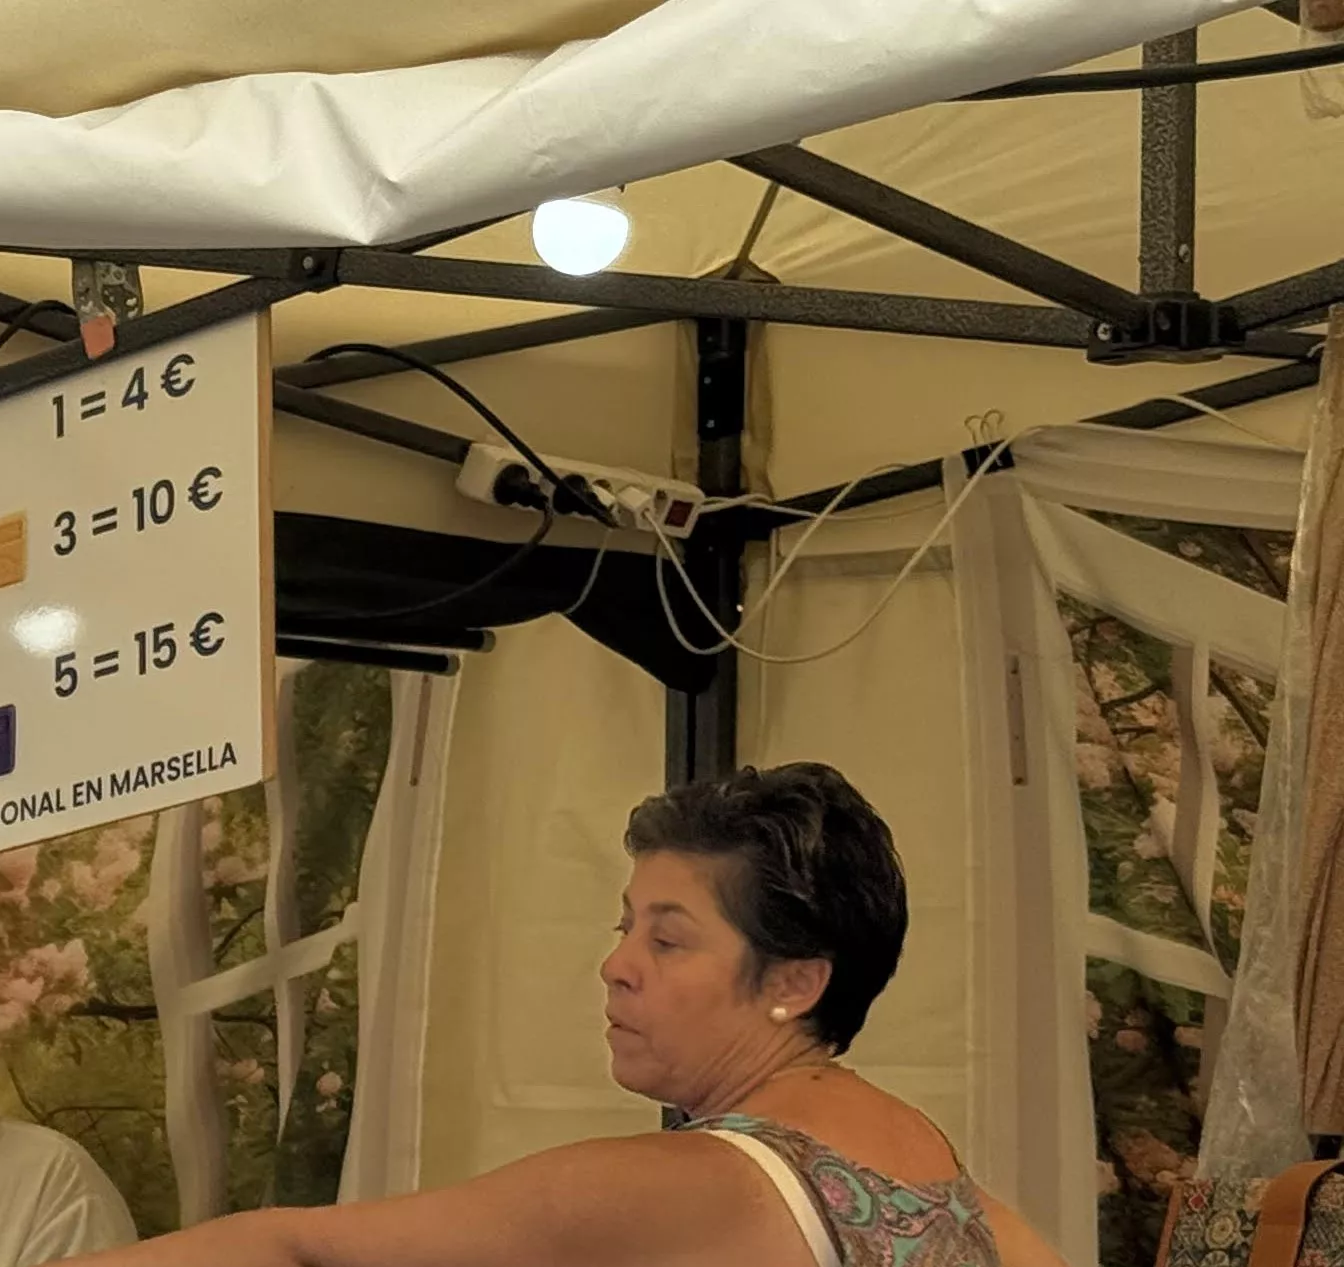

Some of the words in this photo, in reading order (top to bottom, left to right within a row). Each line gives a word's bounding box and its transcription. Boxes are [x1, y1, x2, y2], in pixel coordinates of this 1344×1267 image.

[53, 395, 64, 438] 1
[81, 391, 105, 419] =
[122, 367, 148, 410] 4
[161, 354, 195, 397] €
[54, 511, 76, 555] 3
[93, 508, 117, 535] =
[133, 480, 174, 531] 10
[188, 467, 222, 510] €
[56, 652, 77, 697] 5
[94, 651, 119, 678] =
[135, 623, 176, 675] 15
[190, 612, 224, 656] €
[73, 778, 102, 807] EN
[109, 743, 237, 797] MARSELLA
